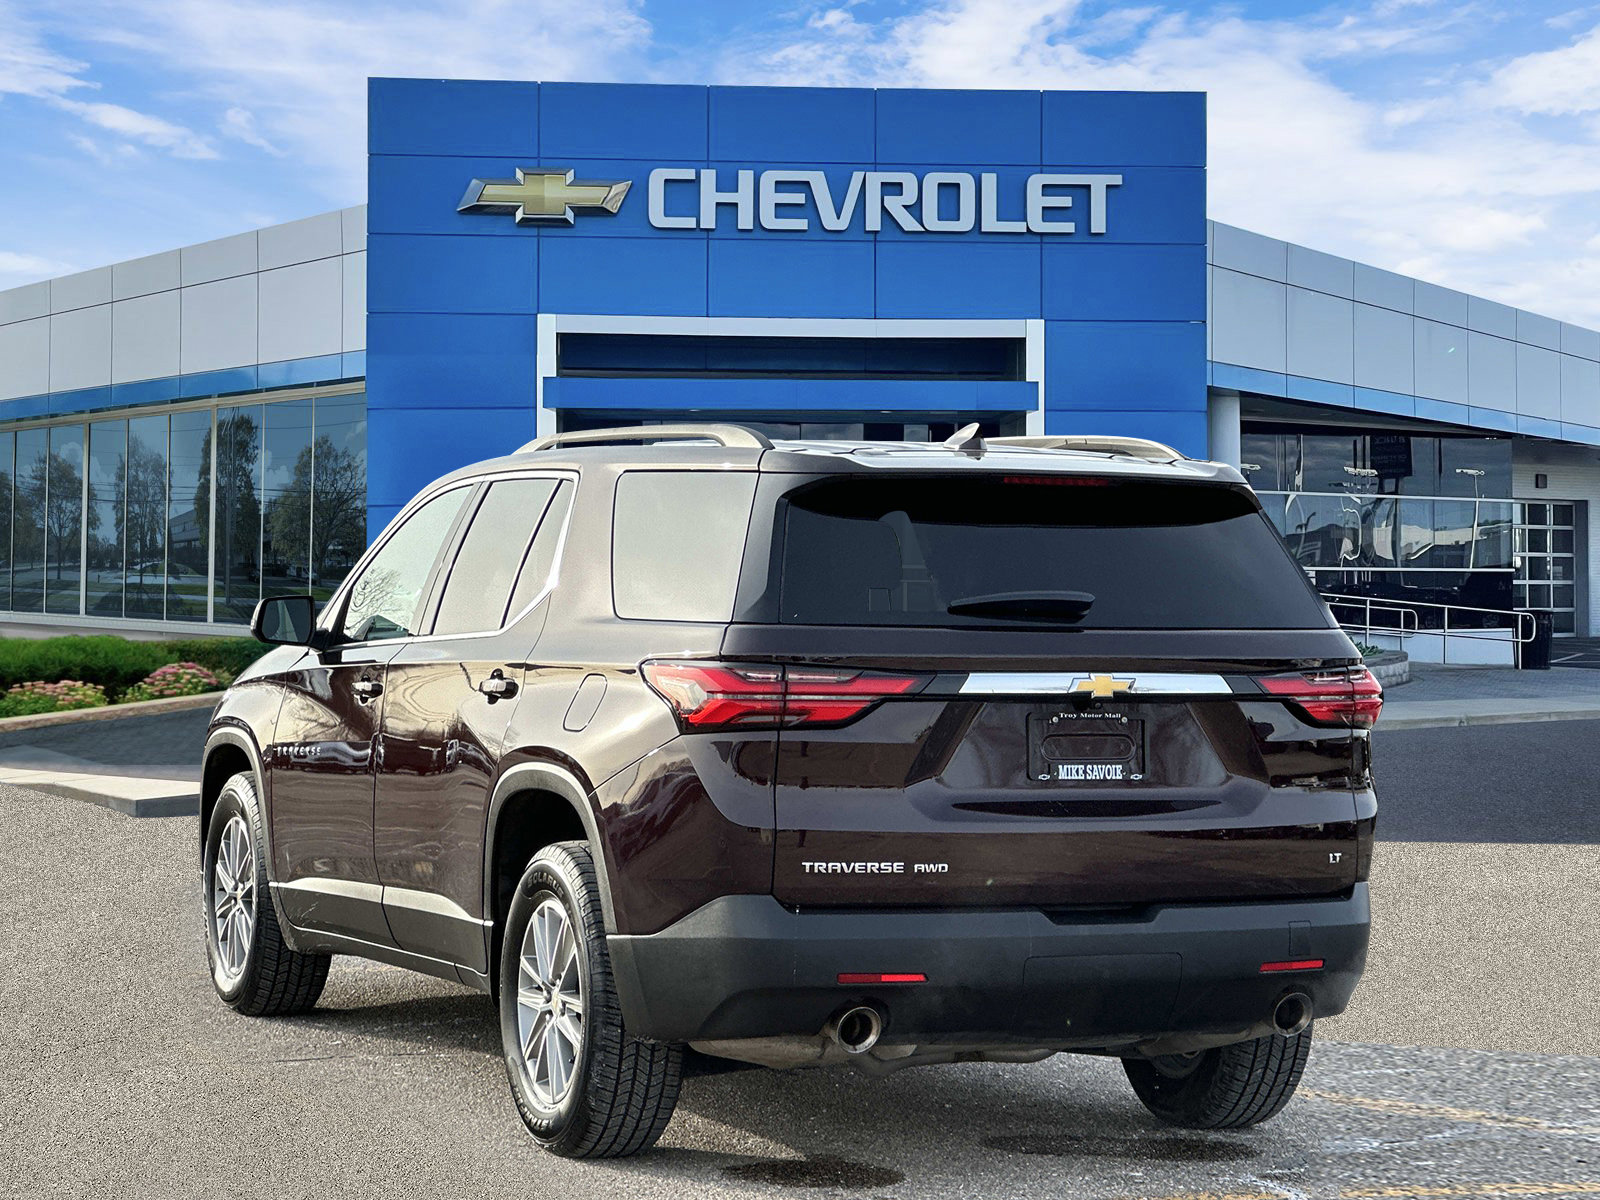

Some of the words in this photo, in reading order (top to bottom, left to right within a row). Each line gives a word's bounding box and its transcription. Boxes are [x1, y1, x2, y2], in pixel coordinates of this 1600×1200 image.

[648, 167, 1123, 235] CHEVROLET
[1058, 764, 1085, 780] MIKE
[1086, 764, 1123, 780] SAVOIE
[1329, 852, 1342, 864] LT
[801, 861, 905, 874] TRAVERSE
[914, 863, 949, 873] AWD
